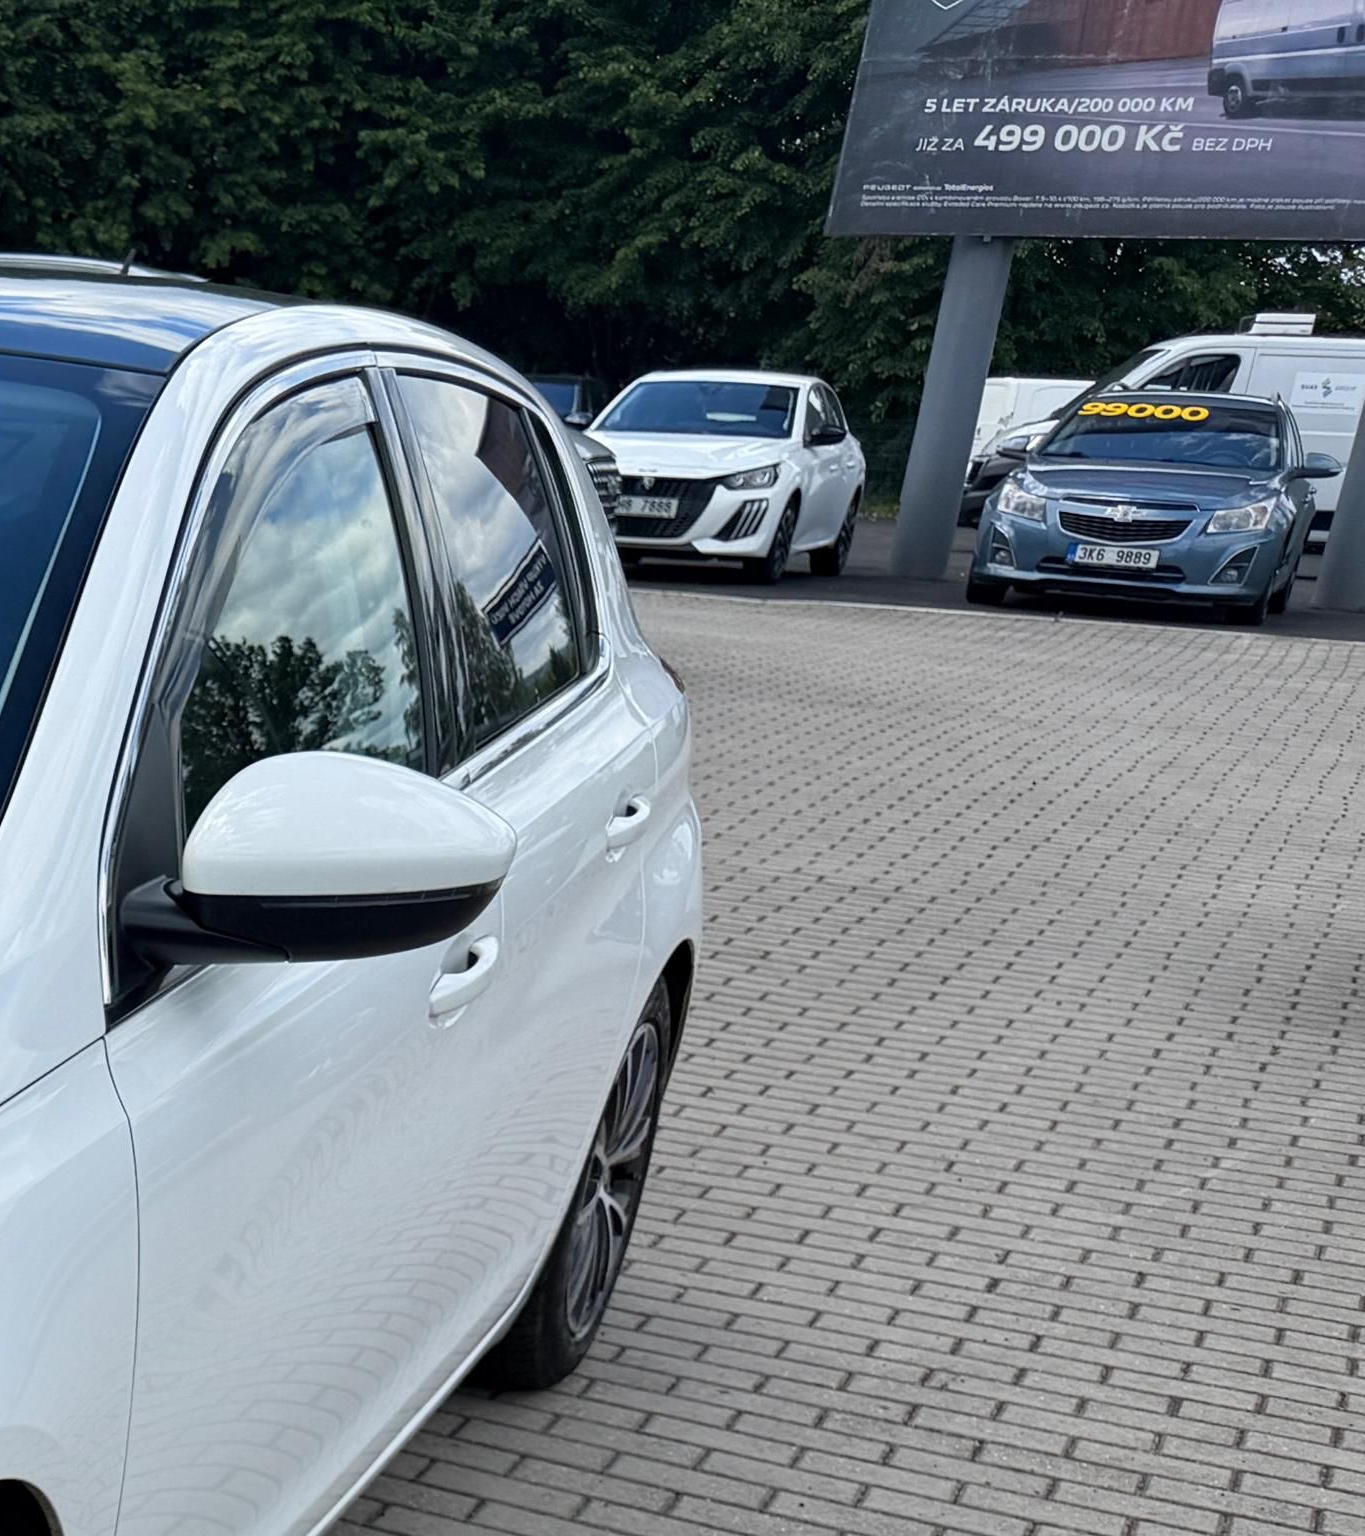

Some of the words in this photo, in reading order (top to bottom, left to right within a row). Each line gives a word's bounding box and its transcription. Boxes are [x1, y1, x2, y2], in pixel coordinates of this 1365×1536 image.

[924, 98, 937, 113] 5
[941, 98, 980, 113] LET
[982, 95, 1113, 114] ZÁRUKA/200
[1118, 98, 1156, 113] 000
[1160, 97, 1195, 113] KM
[915, 135, 939, 151] JIŽ
[942, 138, 965, 151] ZA
[973, 124, 1046, 151] 499
[1054, 124, 1126, 152] 000
[1135, 123, 1185, 152] Kč
[1192, 138, 1227, 151] BEZ
[1232, 138, 1273, 151] DPH
[1078, 402, 1210, 422] 99000
[1078, 546, 1106, 562] 3K6
[1115, 549, 1152, 565] 9889
